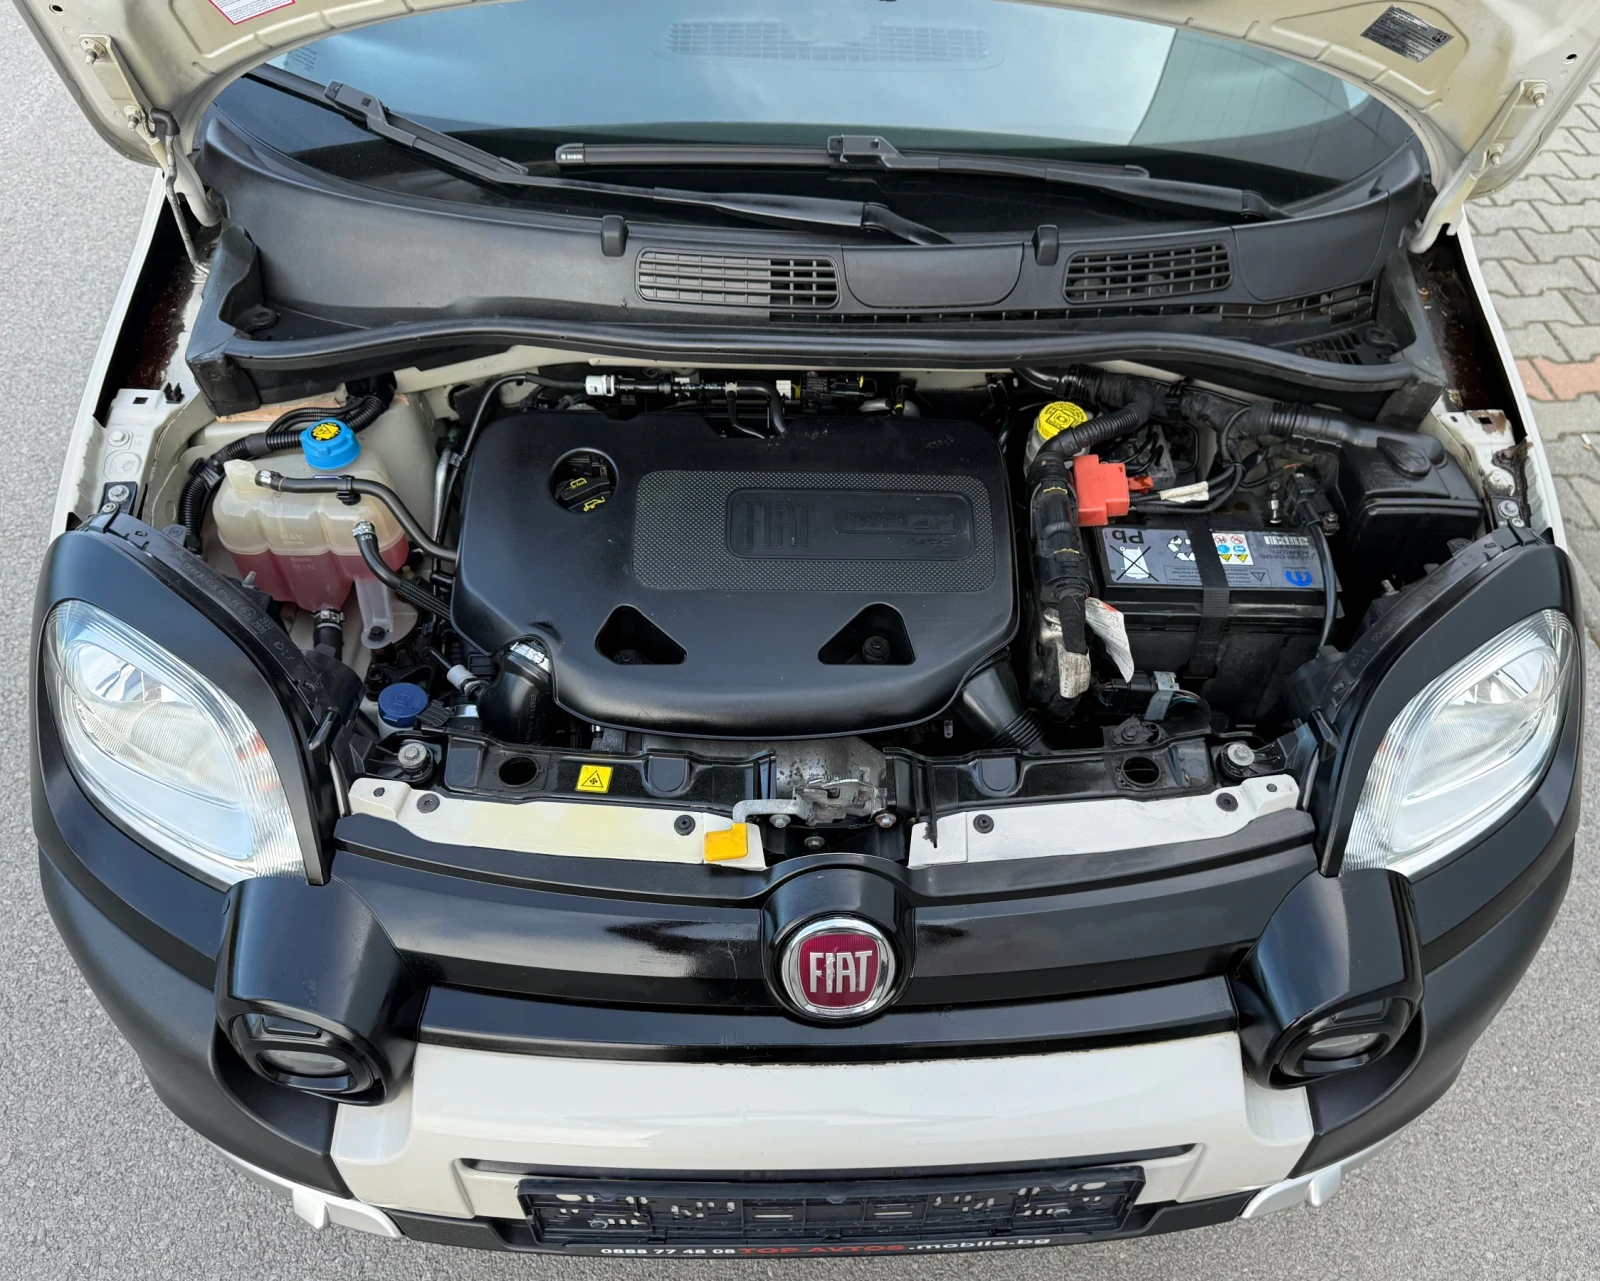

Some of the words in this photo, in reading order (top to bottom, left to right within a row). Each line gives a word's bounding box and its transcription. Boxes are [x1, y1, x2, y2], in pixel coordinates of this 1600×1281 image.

[745, 500, 813, 548] FIAT
[1112, 529, 1144, 544] Pb
[809, 950, 873, 994] FIAT
[738, 1247, 799, 1255] TOP
